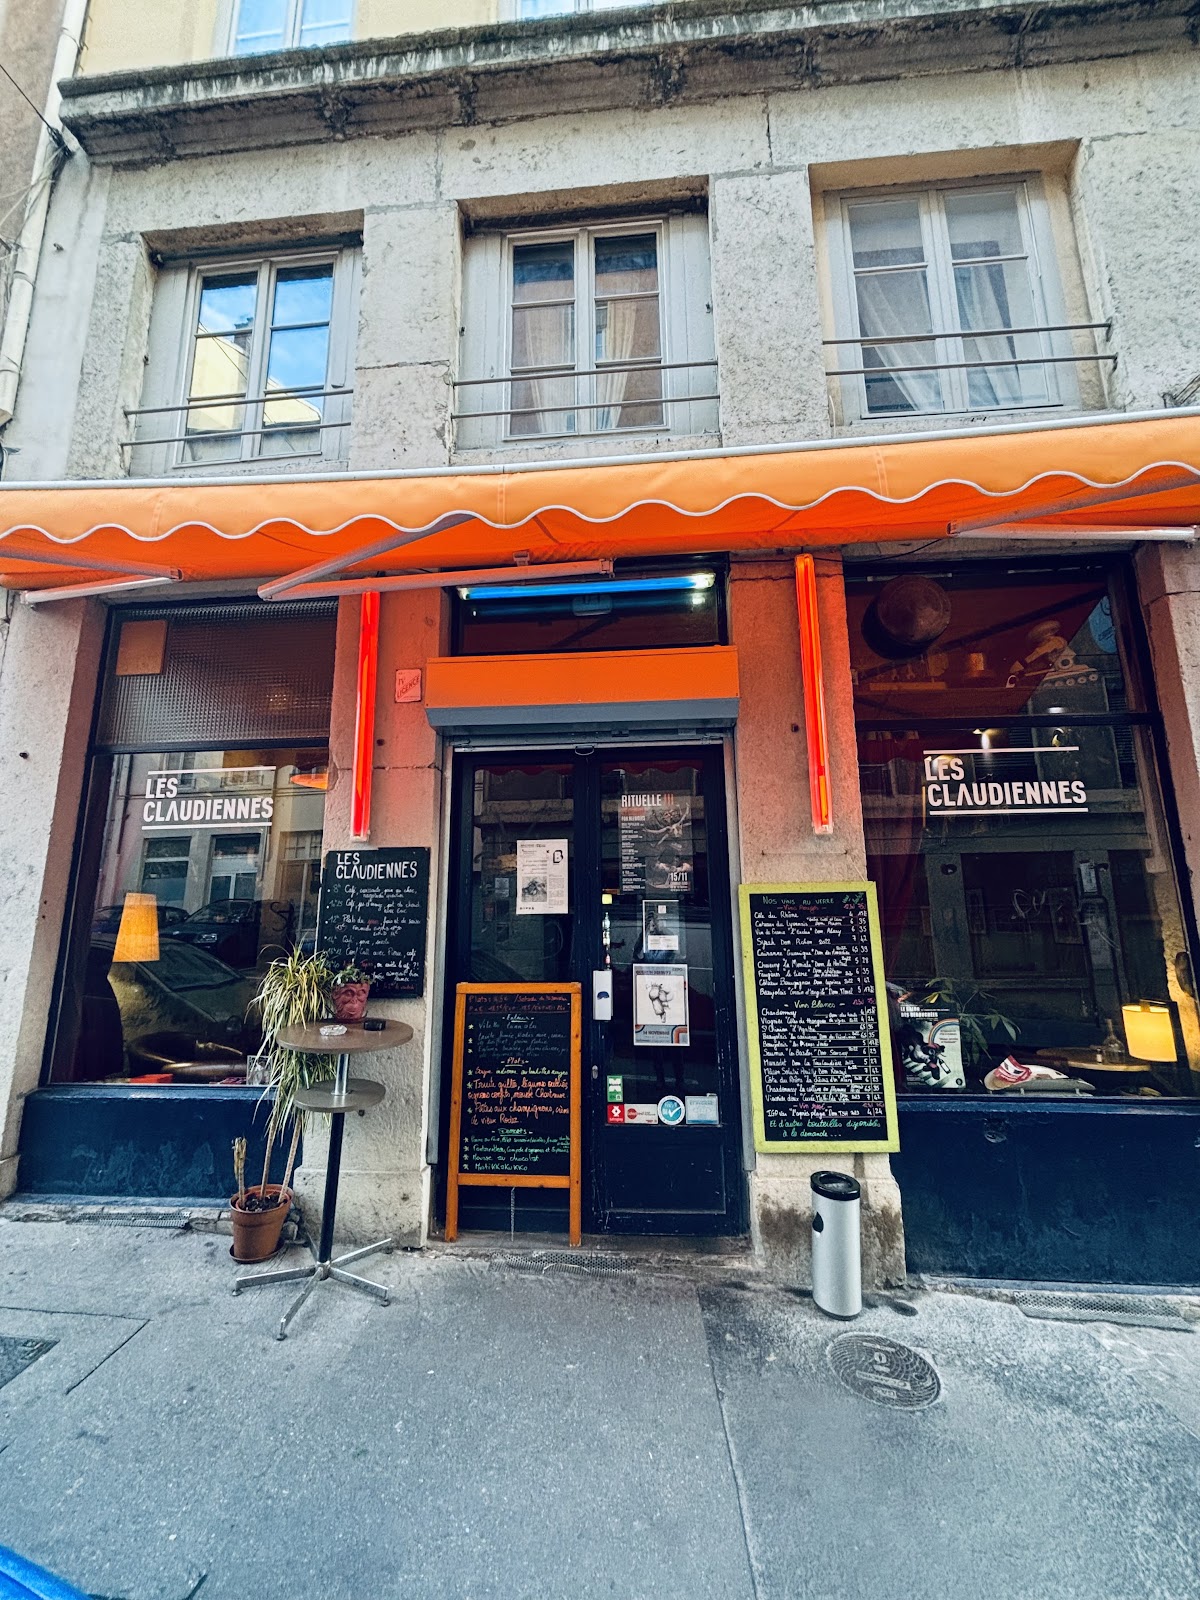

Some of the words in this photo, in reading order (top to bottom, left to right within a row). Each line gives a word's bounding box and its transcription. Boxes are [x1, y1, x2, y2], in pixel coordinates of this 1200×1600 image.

[924, 757, 965, 781] LES
[145, 777, 178, 799] LES
[927, 780, 1087, 807] CLAUDIENNES
[621, 794, 661, 807] RITUELLE
[143, 796, 274, 822] CLAUDIENNES
[337, 852, 361, 865] LES
[336, 861, 418, 880] CLAUDIENNES
[670, 872, 688, 882] 15/11
[757, 937, 776, 950] Syrah
[762, 1007, 797, 1019] Chardonnay
[769, 1120, 777, 1128] Et
[807, 1118, 842, 1128] bouteilles
[800, 1129, 829, 1137] demande
[510, 1153, 540, 1162] chocolat
